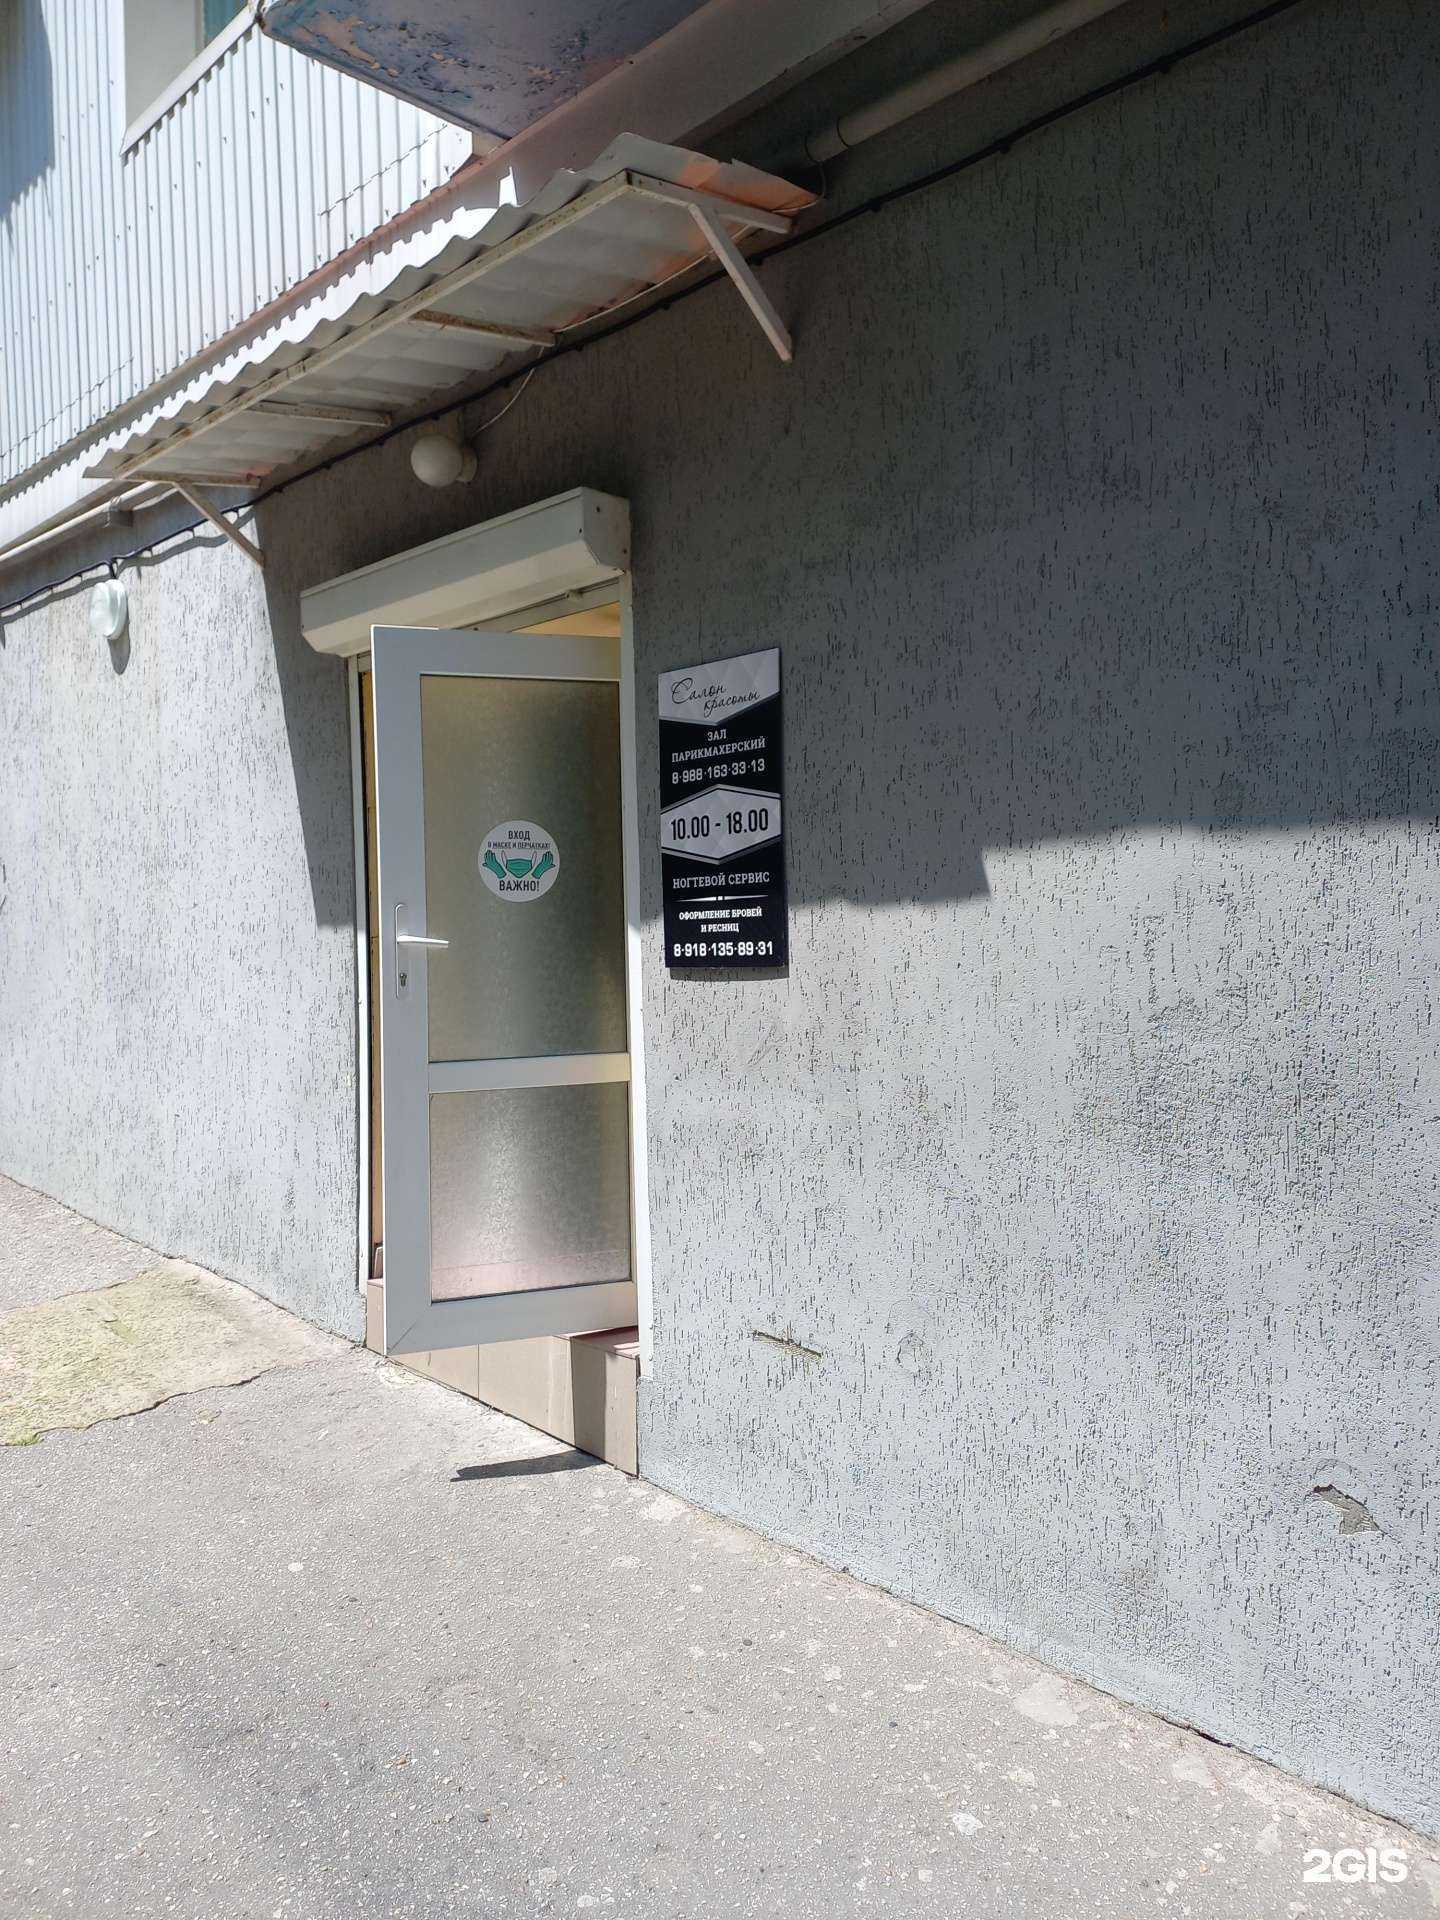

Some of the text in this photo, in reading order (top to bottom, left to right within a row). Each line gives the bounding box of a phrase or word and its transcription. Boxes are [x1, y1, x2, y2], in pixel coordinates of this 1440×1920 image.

[671, 678, 727, 704] Салон
[704, 691, 760, 718] красоты
[707, 729, 727, 741] ЗАЛ
[671, 736, 766, 763] ПАРИКМАХЕРСКИЙ
[670, 815, 710, 840] 10.00
[726, 808, 768, 834] 18.00
[508, 830, 531, 841] ВХОД
[499, 880, 540, 891] ВАЖНО!
[673, 872, 770, 889] НОГТЕВОЙ СЕРВИС
[679, 906, 763, 920] ОФОРМЛЕНИЕ БРОВЕЙ
[700, 923, 740, 933] И РЕСНИЦ
